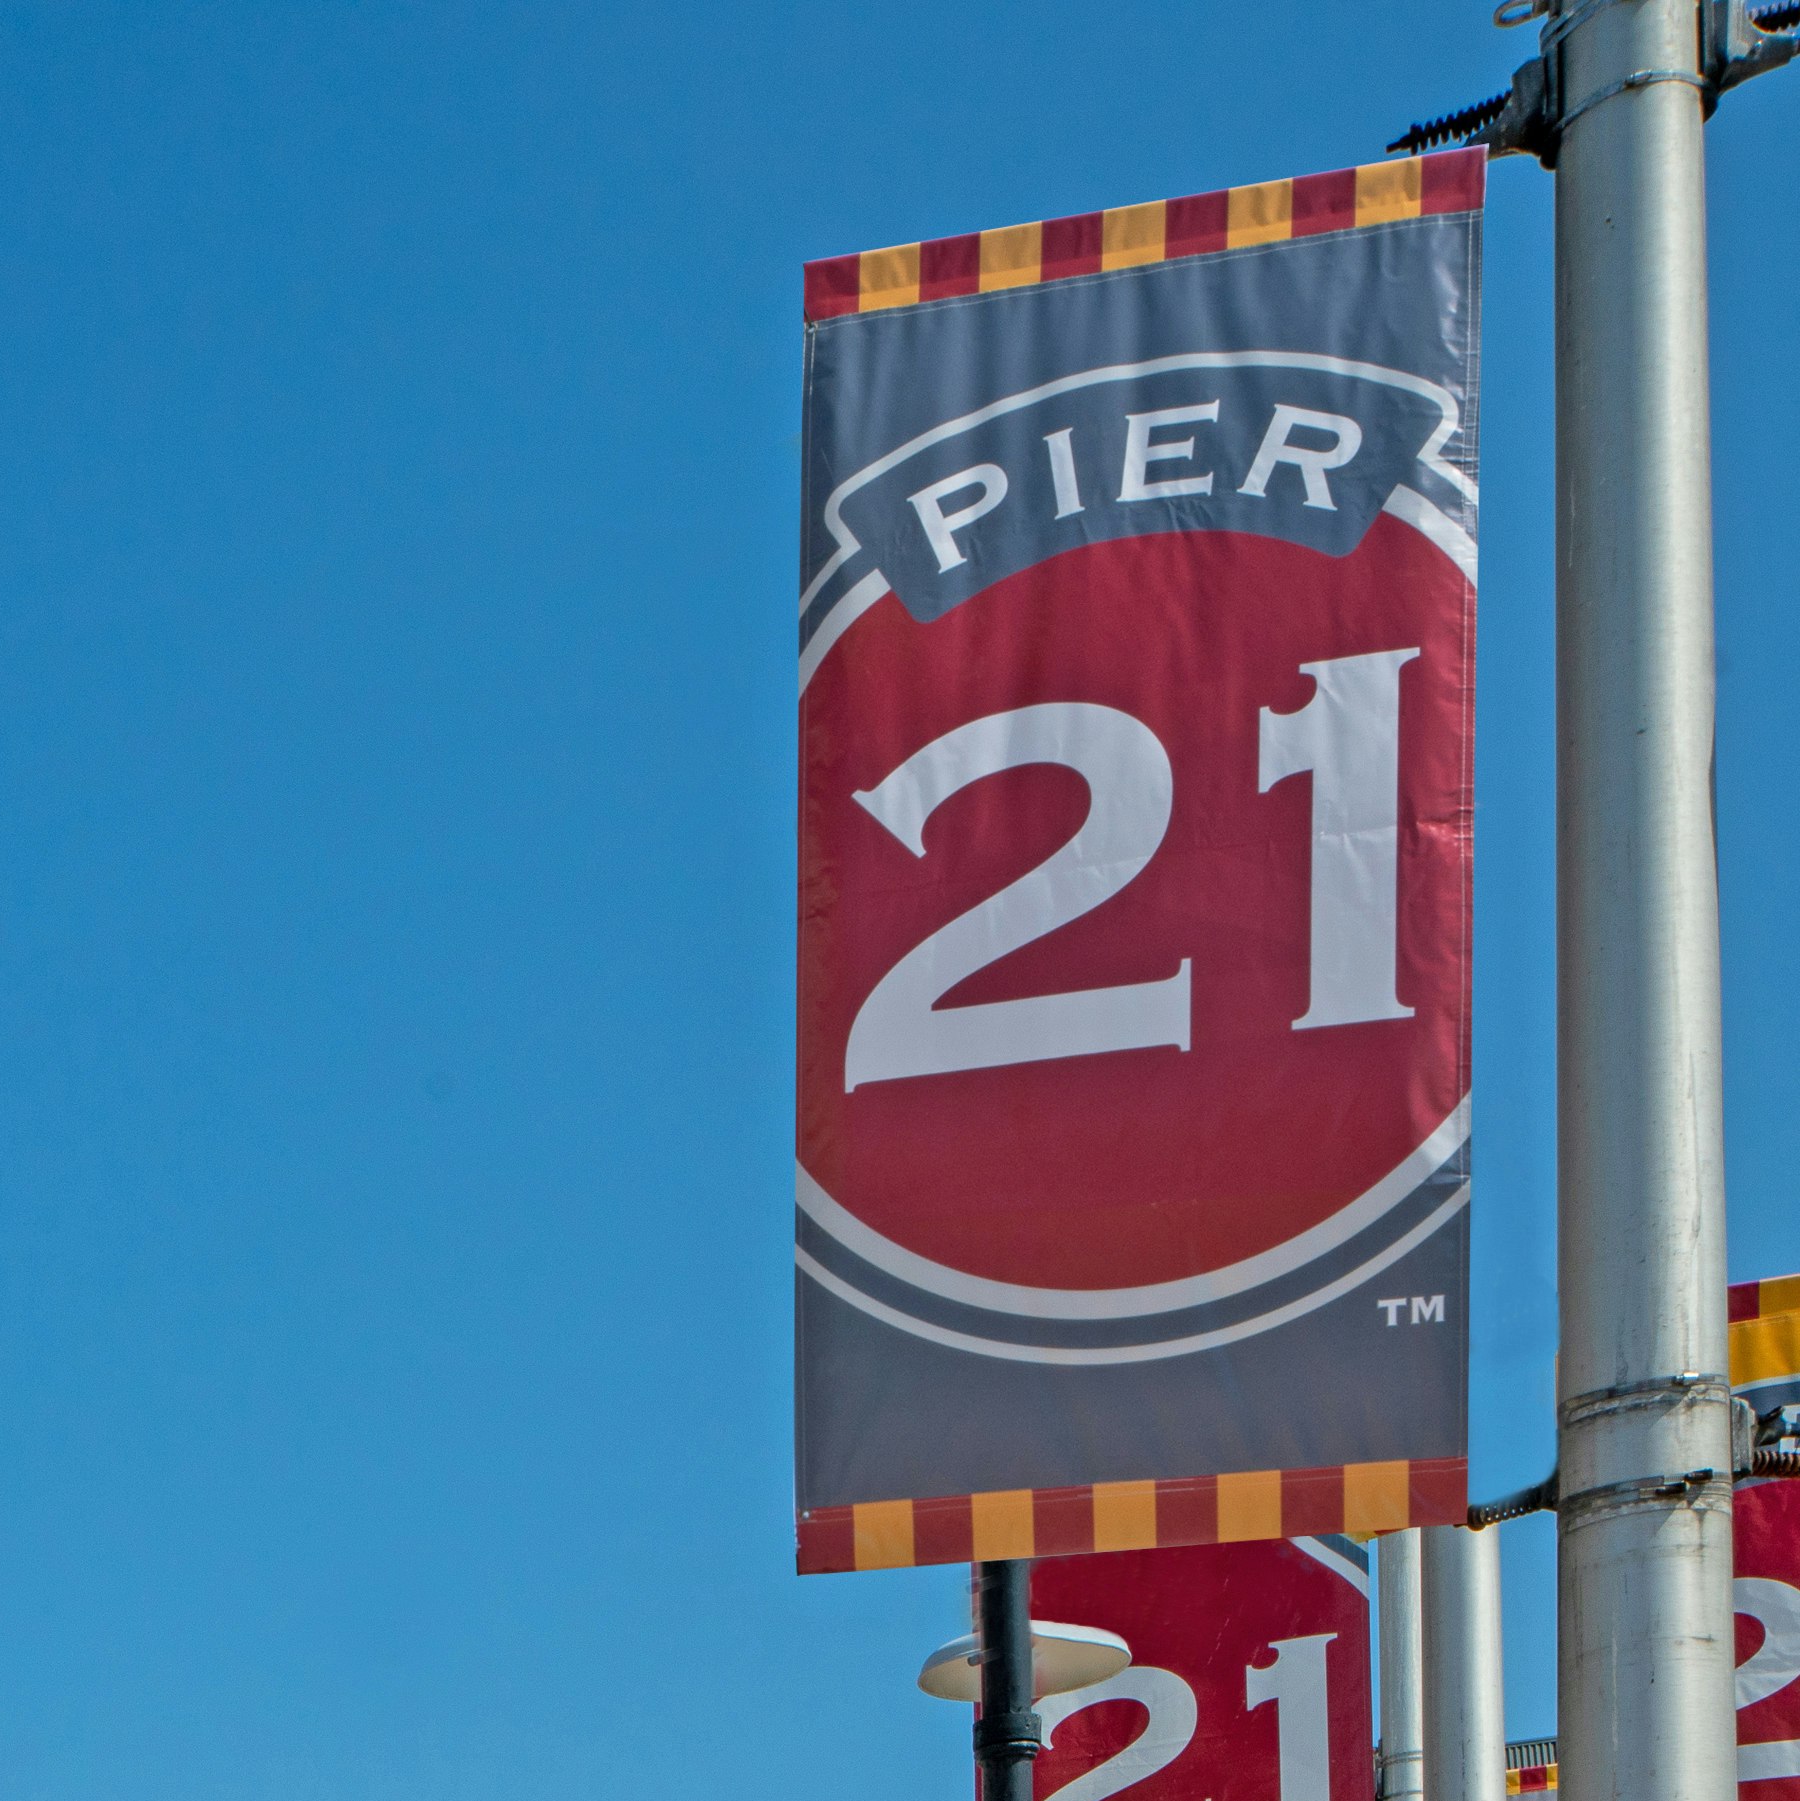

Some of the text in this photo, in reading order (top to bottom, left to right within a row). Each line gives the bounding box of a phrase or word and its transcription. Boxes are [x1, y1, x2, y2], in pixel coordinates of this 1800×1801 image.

[905, 397, 1365, 576] PIER
[843, 646, 1422, 1094] 21
[1378, 1294, 1447, 1329] TM
